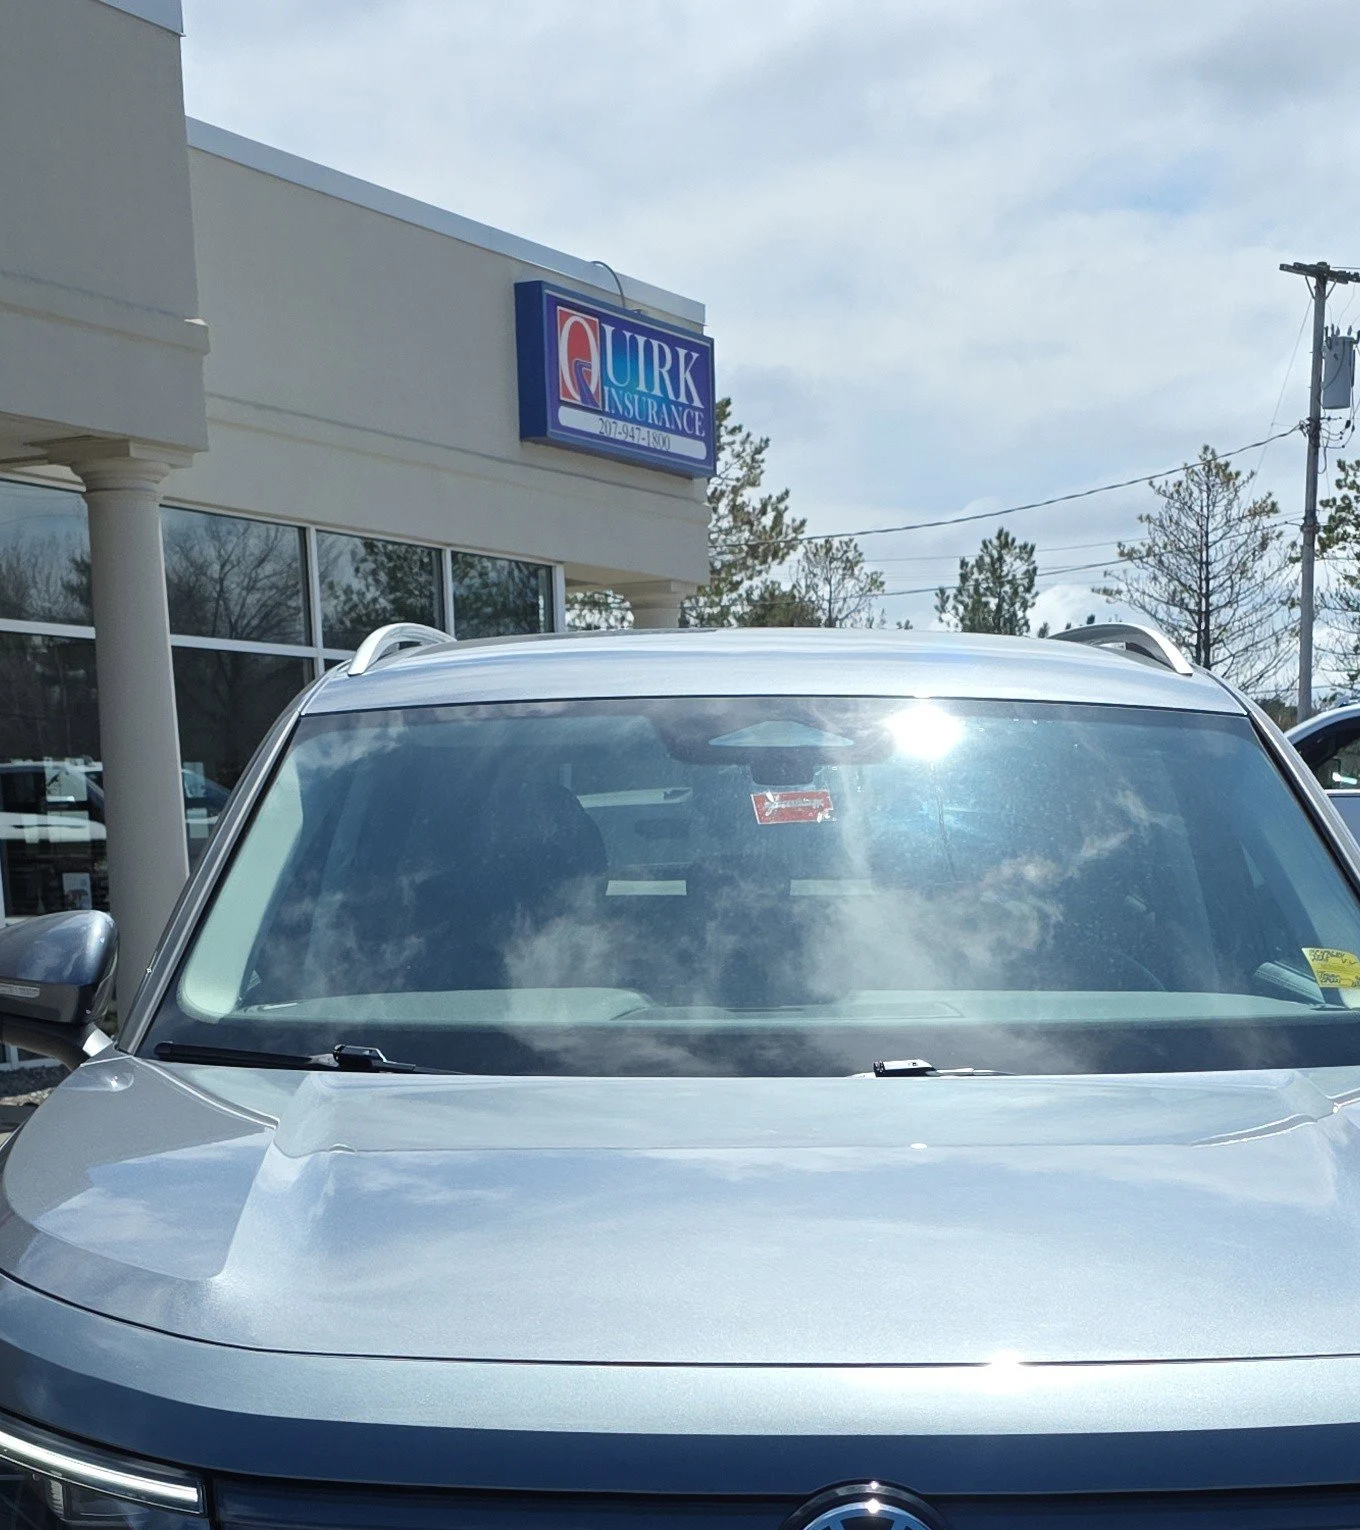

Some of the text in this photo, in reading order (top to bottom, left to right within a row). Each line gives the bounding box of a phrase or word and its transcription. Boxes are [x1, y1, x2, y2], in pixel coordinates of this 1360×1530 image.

[558, 308, 705, 409] QUIRK
[598, 417, 671, 451] 207-947-1800
[603, 386, 706, 437] INSURANCE
